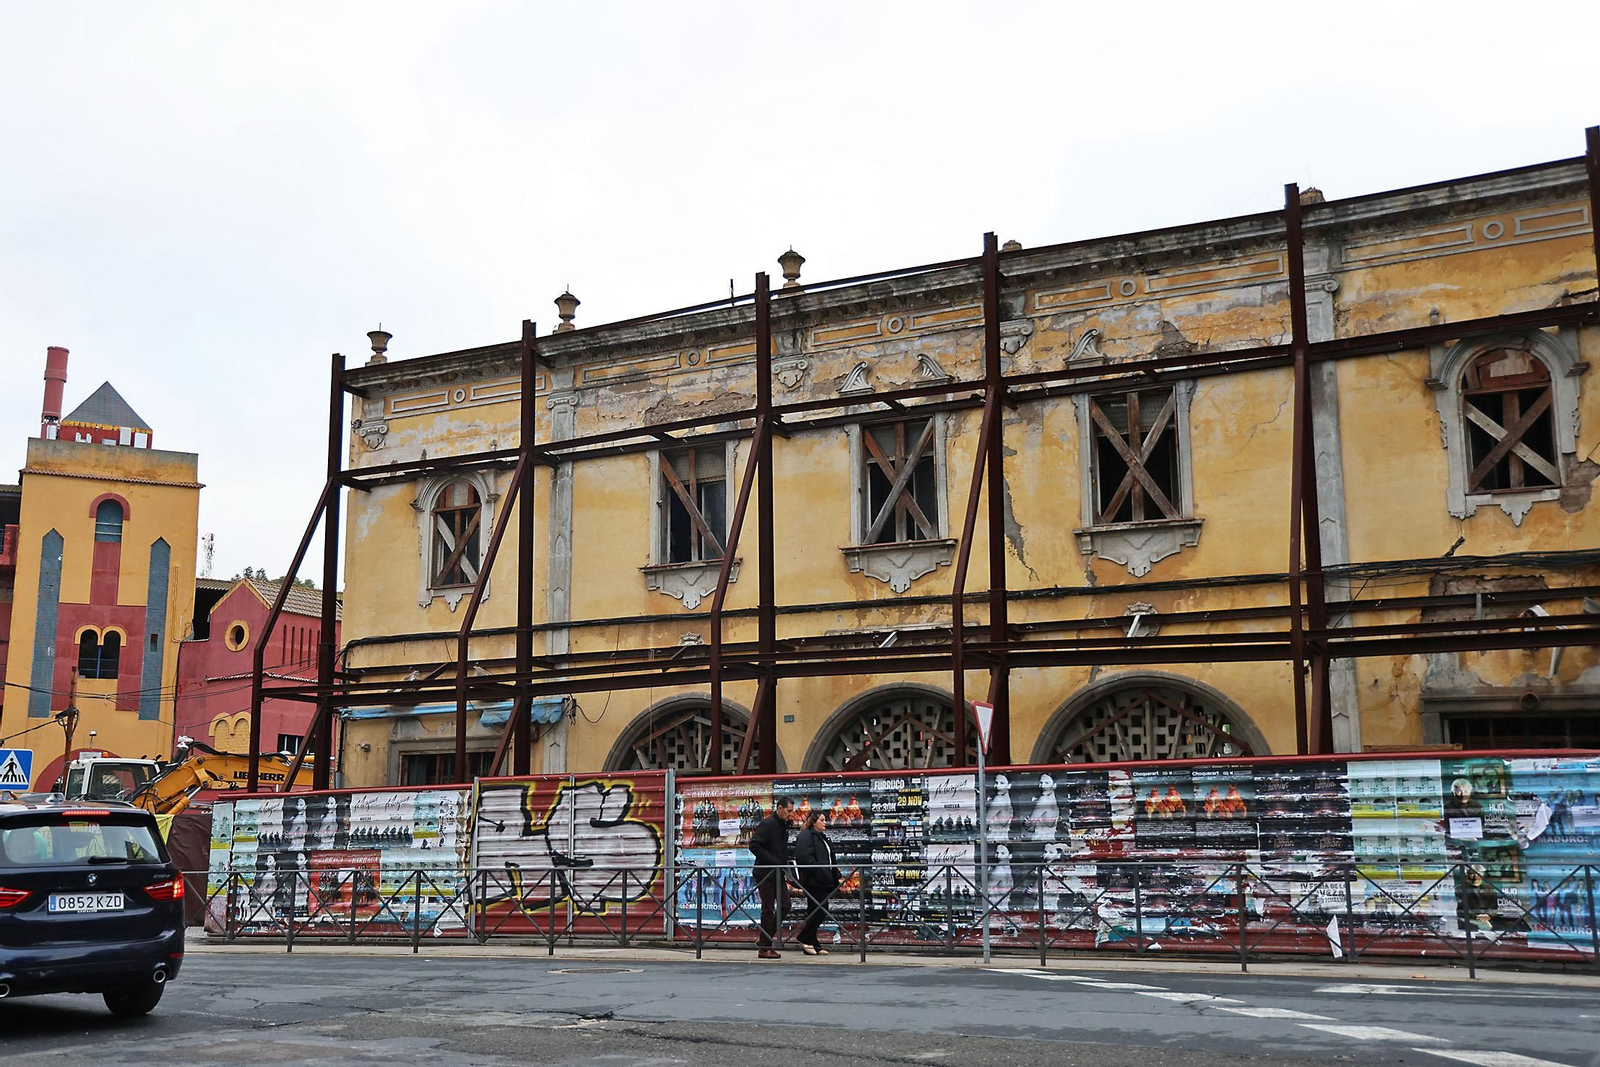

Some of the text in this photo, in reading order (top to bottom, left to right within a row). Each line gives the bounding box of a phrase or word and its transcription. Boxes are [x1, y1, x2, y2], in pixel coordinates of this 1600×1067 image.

[233, 771, 285, 781] LIEHERR
[897, 796, 907, 806] 29
[58, 895, 122, 909] 0852 KZD
